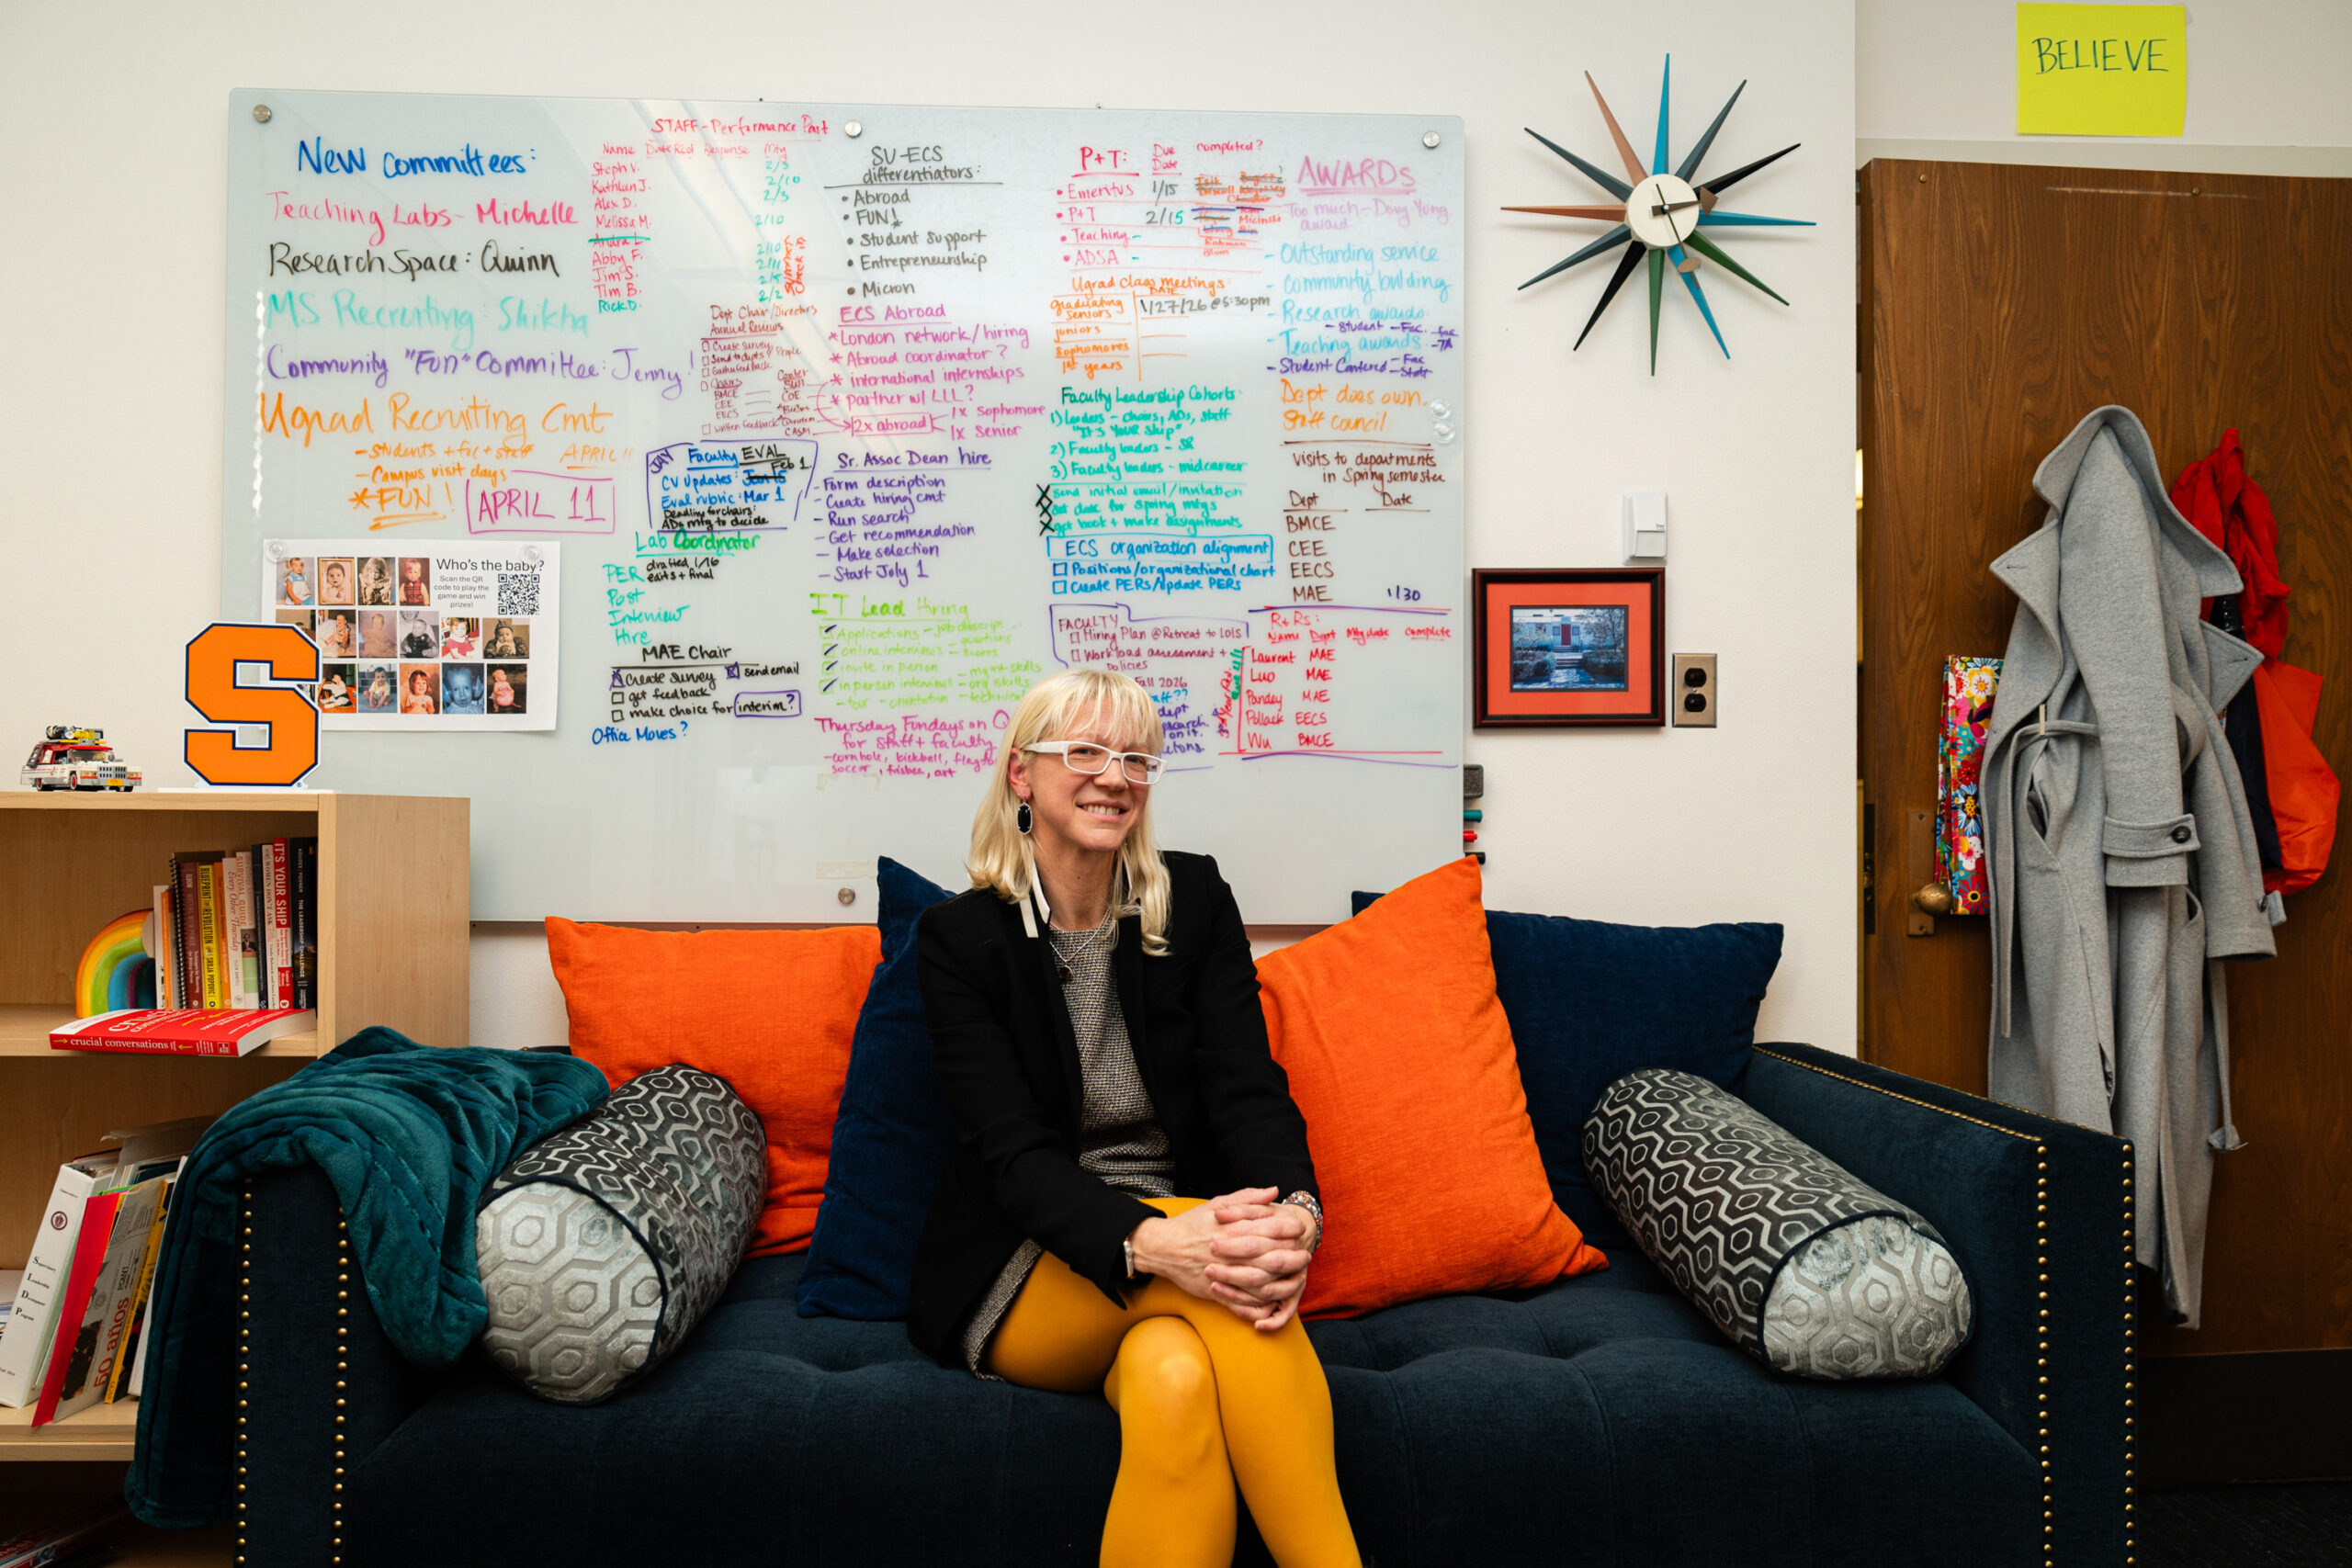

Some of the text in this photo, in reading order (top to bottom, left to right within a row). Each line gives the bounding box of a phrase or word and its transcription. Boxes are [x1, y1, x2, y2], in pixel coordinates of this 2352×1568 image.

[2032, 38, 2168, 74] BELIEVE
[299, 136, 366, 175] New
[603, 143, 635, 154] Name
[1152, 144, 1175, 158] Due
[593, 162, 628, 178] Steph
[1152, 157, 1178, 171] Date
[854, 188, 910, 208] Abroad
[1069, 183, 1134, 199] Emeritus
[1153, 180, 1179, 206] 1/15
[594, 197, 618, 210] Alex
[266, 191, 386, 247] Teaching
[476, 198, 577, 226] Michelle
[596, 214, 635, 228] Melissa
[1147, 208, 1183, 225] 2/15
[860, 229, 987, 252] Student Support
[1071, 228, 1130, 248] Teaching
[270, 242, 385, 276] Research
[481, 240, 560, 277] Quinn
[860, 251, 987, 272] Entrepreneurship
[1075, 249, 1118, 265] ADSA
[1280, 242, 1374, 276] Outstanding
[592, 266, 621, 282] Jim
[594, 284, 621, 299] Tim
[863, 281, 915, 298] Micron
[1069, 276, 1115, 299] Ugrad
[1378, 268, 1453, 303] building
[267, 289, 320, 329] MS
[498, 296, 588, 338] Shikha
[840, 304, 945, 323] ECS Abroad
[1283, 299, 1360, 324] Research
[841, 330, 895, 345] London
[1054, 326, 1101, 344] juniors
[1279, 328, 1353, 363] Teaching
[267, 345, 389, 388] Community
[847, 352, 899, 367] Abroad
[1280, 356, 1387, 374] Student Centered
[851, 367, 1023, 388] international internships
[1084, 361, 1123, 380] years
[846, 390, 903, 411] partner
[1062, 386, 1185, 412] Faculty Leadership
[1281, 378, 1374, 413] Dept does
[260, 391, 613, 451] Ugrad Recruiting Cmt
[876, 415, 926, 432] abroad
[1283, 409, 1325, 431] Staff
[686, 445, 783, 468] Faculty EVAL
[864, 446, 991, 467] Assoc Dean hire
[1335, 452, 1437, 472] to departments
[1069, 460, 1119, 478] Faculty
[1323, 468, 1445, 489] in Spring semester
[662, 475, 678, 491] CV
[823, 474, 945, 494] Form description
[479, 485, 605, 523] APRIL 11
[662, 490, 769, 510] Eval Mar
[1287, 490, 1412, 511] Dept Date
[829, 508, 910, 526] Run search
[1286, 515, 1336, 533] BMCE
[636, 526, 762, 553] Lab Coordinator
[829, 525, 974, 544] Get recommendation
[838, 542, 939, 562] Make selection
[1066, 538, 1271, 566] ECS organization alignment
[1289, 540, 1327, 557] CEE
[436, 558, 544, 573] Who's the baby?
[602, 564, 645, 583] PER
[647, 558, 689, 571] drafted
[689, 568, 714, 580] final
[834, 558, 929, 582] Start 1
[1239, 563, 1275, 578] chart
[1291, 561, 1334, 579] EECS
[1207, 577, 1241, 591] PERs
[1293, 585, 1332, 602] MAE
[606, 588, 645, 607] Post
[809, 592, 905, 617] IT Lead
[1058, 615, 1118, 632] FACULTY
[1120, 626, 1146, 639] Plan
[615, 627, 651, 647] Hire
[642, 644, 731, 662] MAE Chair
[1148, 648, 1215, 658] assessment
[1251, 648, 1335, 663] Laurent MAE
[1159, 677, 1184, 688] 2026
[1306, 667, 1332, 682] MAE
[185, 623, 320, 786] S
[628, 687, 711, 707] get feedback
[1302, 689, 1330, 703] MAE
[629, 701, 730, 718] make for
[1245, 709, 1327, 727] Pollack EECS
[592, 726, 631, 745] Office
[814, 715, 987, 741] Thursday Fundays on
[842, 731, 866, 750] for
[1248, 732, 1334, 750] Wu BMCE
[934, 768, 956, 777] art
[275, 843, 285, 862] IT'S
[236, 856, 245, 894] SURVIVAL
[276, 867, 286, 896] YOUR
[200, 867, 213, 944] BLUEPRINT REVOLUTION
[230, 893, 238, 913] Other
[277, 900, 287, 925] SHIP
[231, 917, 240, 952] Thursday
[71, 1038, 168, 1049] crucial conversations
[118, 1266, 130, 1291] POINT
[94, 1297, 129, 1388] 50 años
